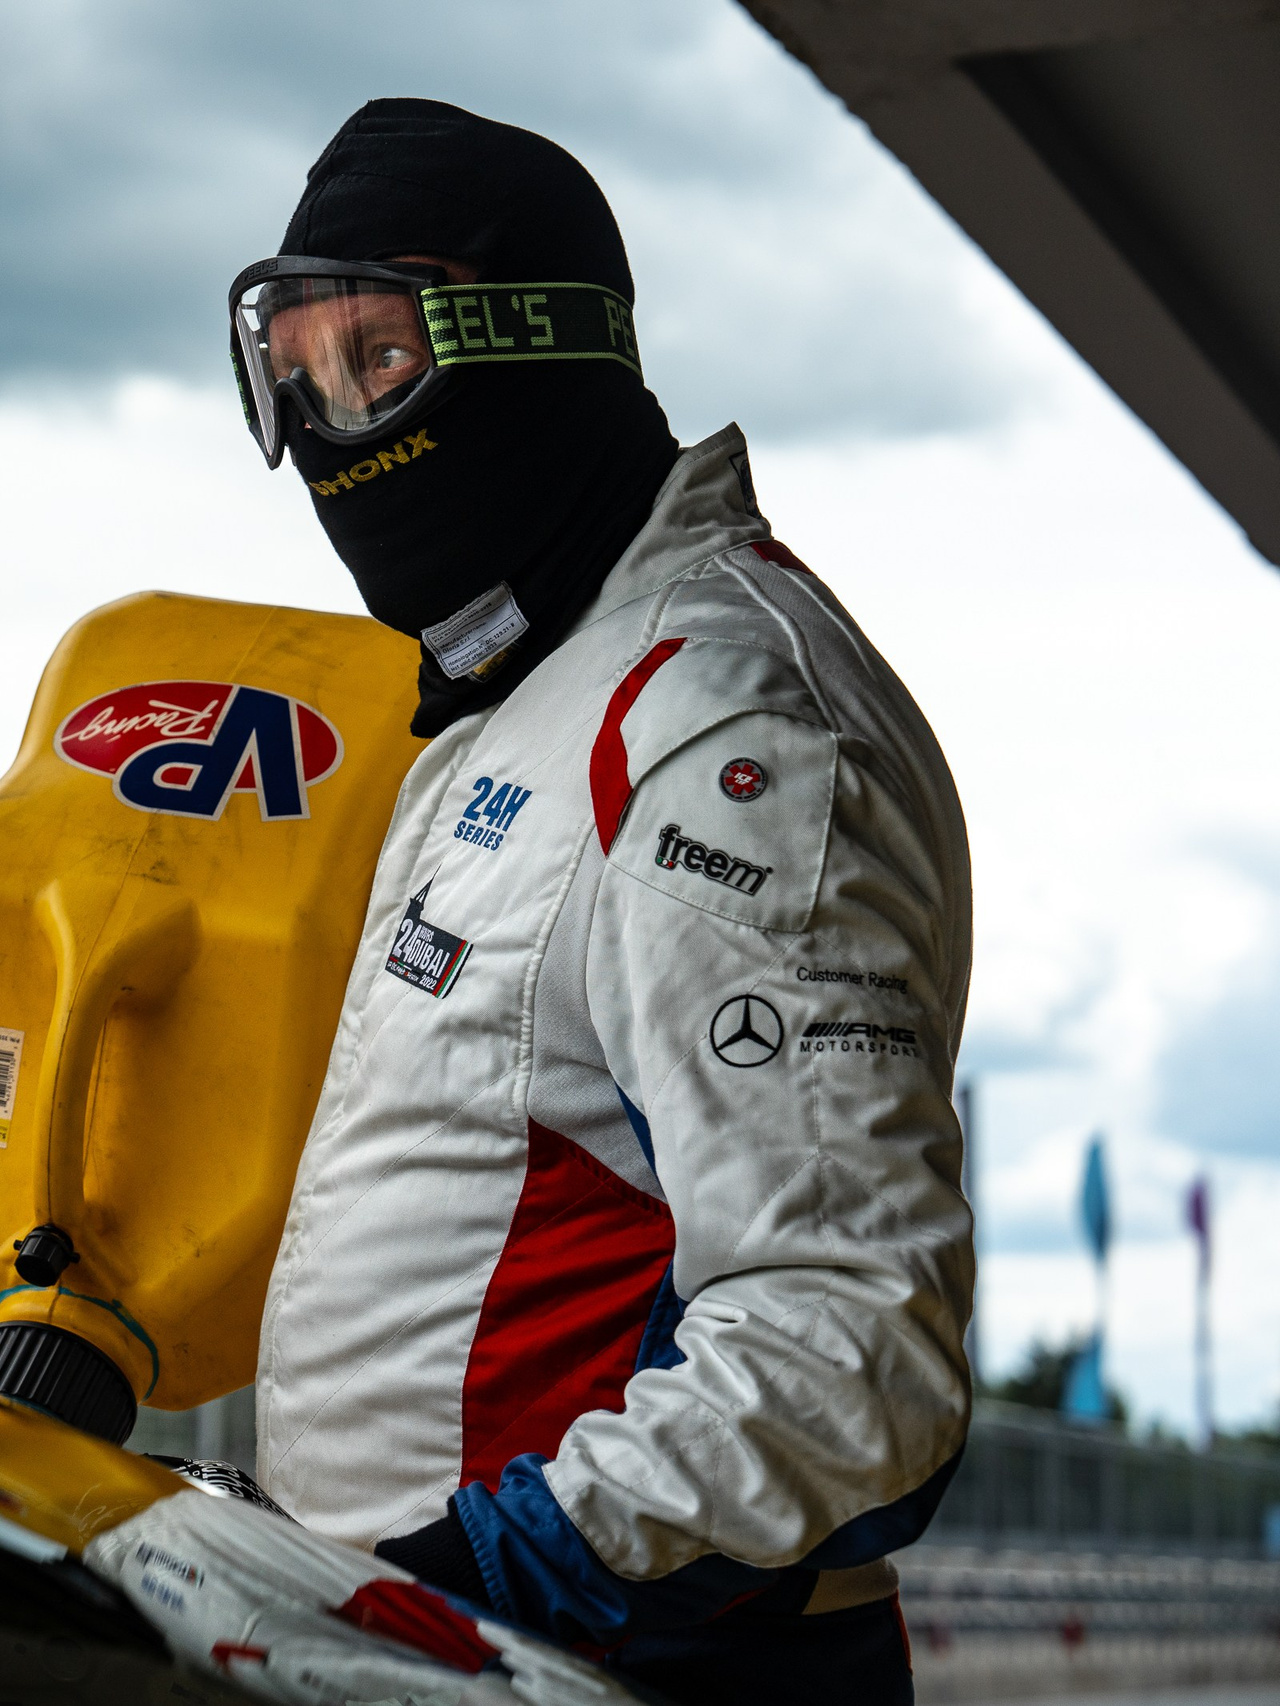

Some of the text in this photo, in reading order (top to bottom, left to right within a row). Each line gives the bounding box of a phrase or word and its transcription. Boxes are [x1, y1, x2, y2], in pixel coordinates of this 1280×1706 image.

[62, 684, 309, 821] VP Racing
[462, 775, 533, 834] 24H
[453, 820, 505, 852] SERIES
[659, 825, 766, 894] freem
[391, 917, 420, 963] 24
[407, 937, 451, 979] DUBAI
[419, 973, 438, 991] 2022
[796, 966, 909, 994] Customer Racing
[799, 1040, 921, 1058] MOTORSPORT
